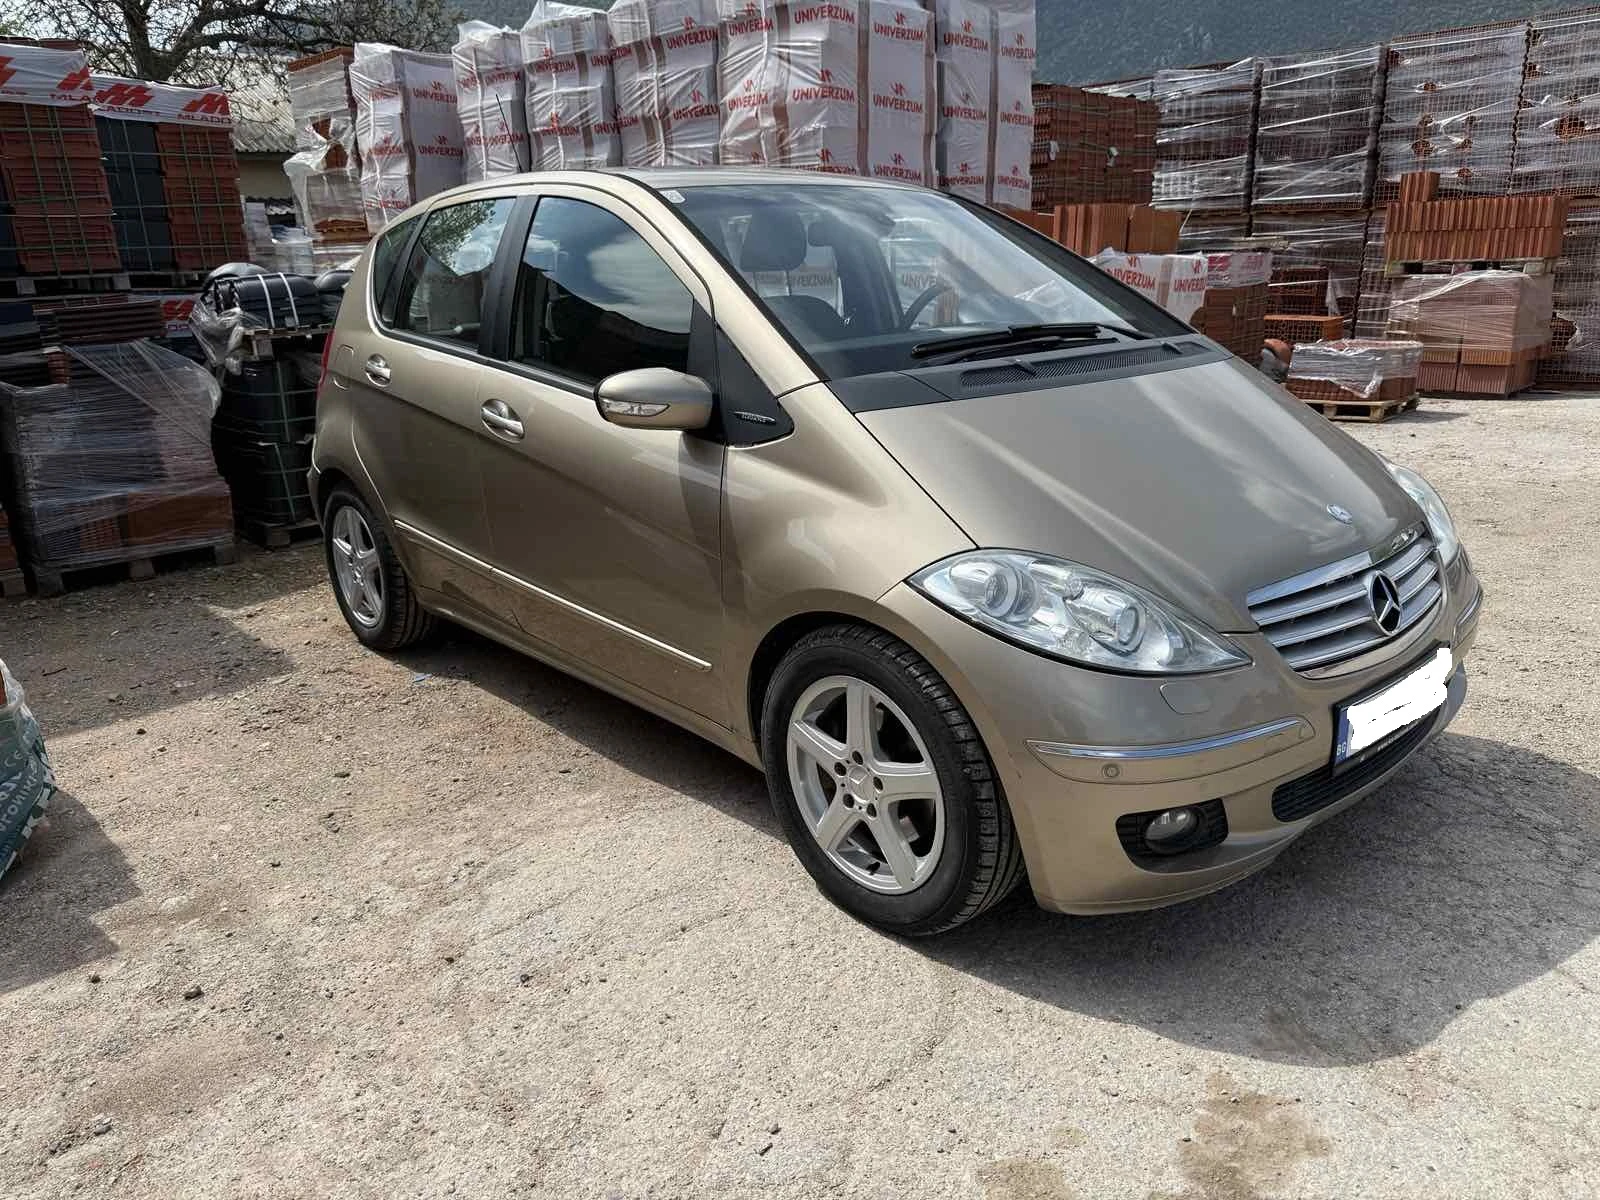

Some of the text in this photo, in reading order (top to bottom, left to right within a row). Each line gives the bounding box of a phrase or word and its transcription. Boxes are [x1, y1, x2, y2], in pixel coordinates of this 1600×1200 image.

[794, 4, 856, 24] UNIVERZUM
[874, 22, 925, 41] UNIVERZUM
[943, 33, 989, 50] UNIVERZUM
[792, 86, 856, 104] UNIVERZUM
[873, 94, 923, 113] UNIVERZUM
[873, 163, 921, 181] UNIVERZUM
